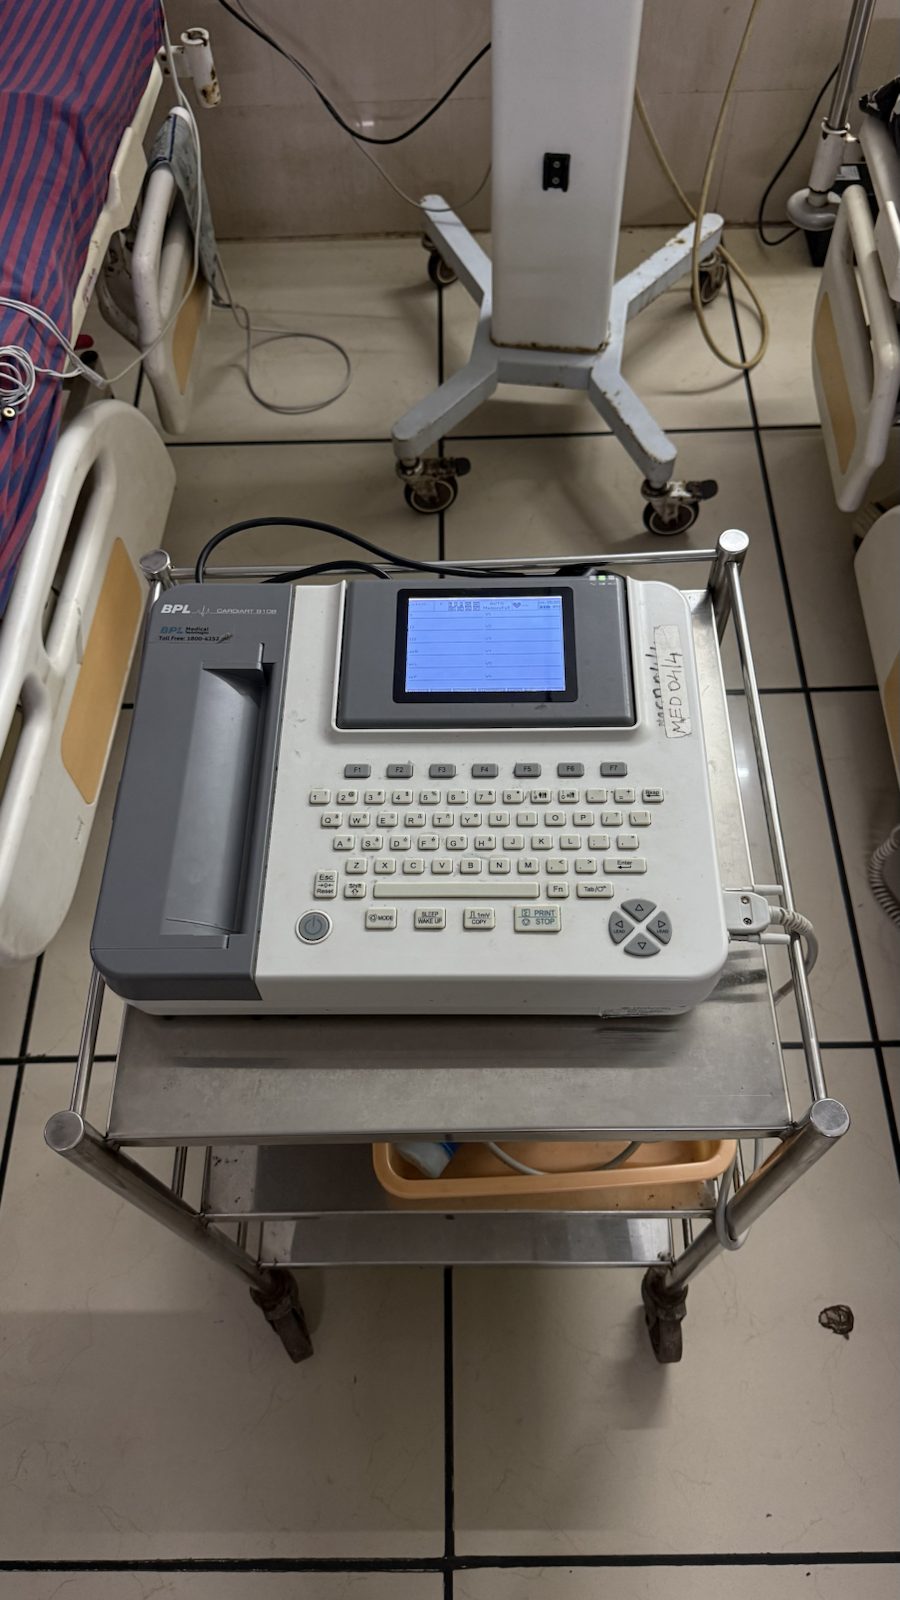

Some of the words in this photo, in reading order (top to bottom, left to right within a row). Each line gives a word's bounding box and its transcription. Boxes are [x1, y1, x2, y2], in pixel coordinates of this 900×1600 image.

[161, 604, 191, 614] BPL
[160, 626, 185, 635] BPL
[668, 696, 686, 734] MED
[535, 918, 555, 926] STOP
